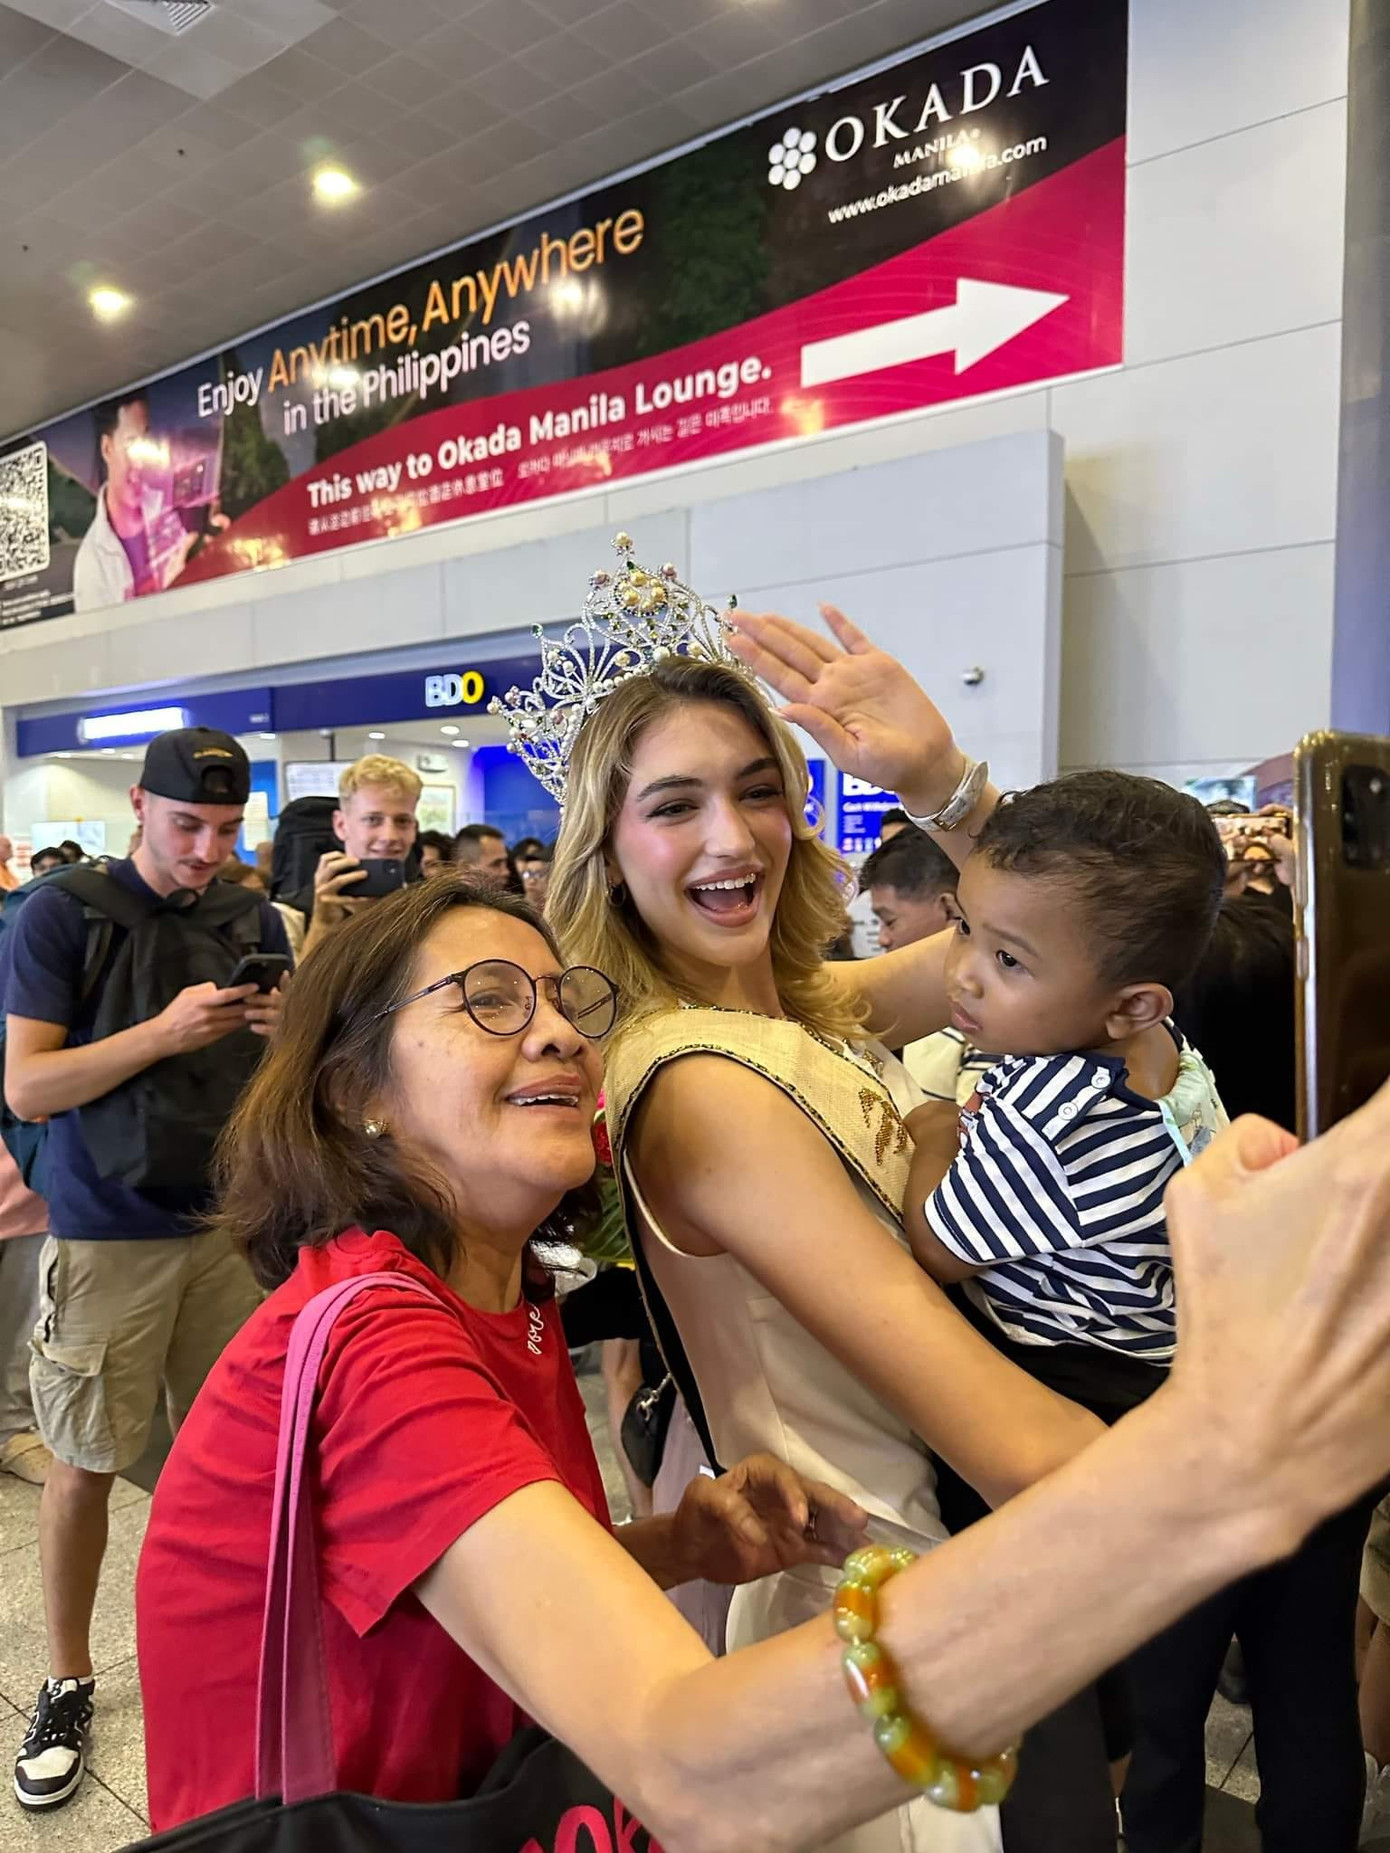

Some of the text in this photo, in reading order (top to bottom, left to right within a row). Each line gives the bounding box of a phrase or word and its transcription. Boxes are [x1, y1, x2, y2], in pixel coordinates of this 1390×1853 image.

[825, 45, 1050, 162] OKADA
[828, 136, 1047, 223] www.okadamana.com
[198, 209, 644, 418] Enjoy Anytime, Anywhere
[283, 320, 531, 436] in the Philippines
[307, 474, 352, 508] This
[355, 461, 402, 493] way
[406, 453, 433, 479] to
[437, 422, 522, 470] Okada
[529, 392, 626, 445] Manila
[635, 355, 772, 416] Lounge.
[425, 671, 484, 707] BDO
